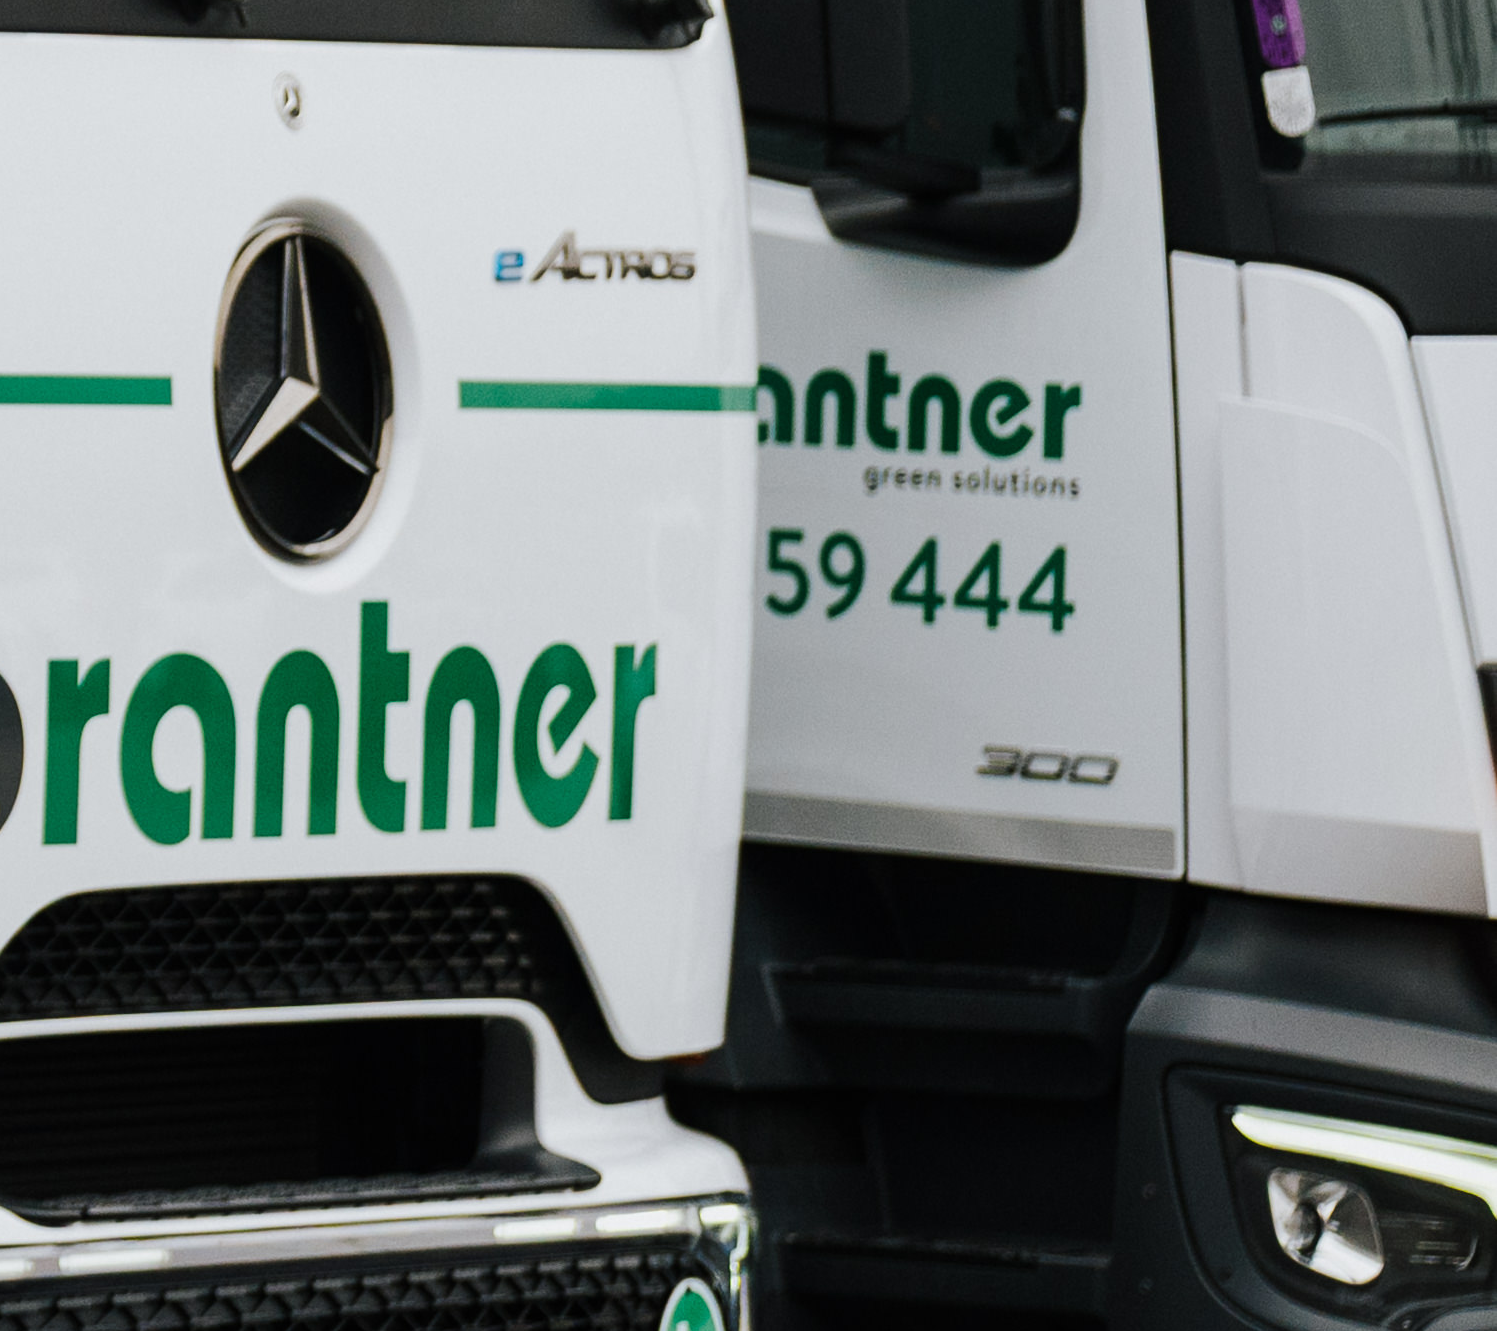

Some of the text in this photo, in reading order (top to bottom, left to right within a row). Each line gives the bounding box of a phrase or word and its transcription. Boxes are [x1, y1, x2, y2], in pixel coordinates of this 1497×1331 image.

[864, 464, 1080, 499] green solutions
[766, 528, 1076, 634] 59 444
[976, 744, 1121, 787] 300
